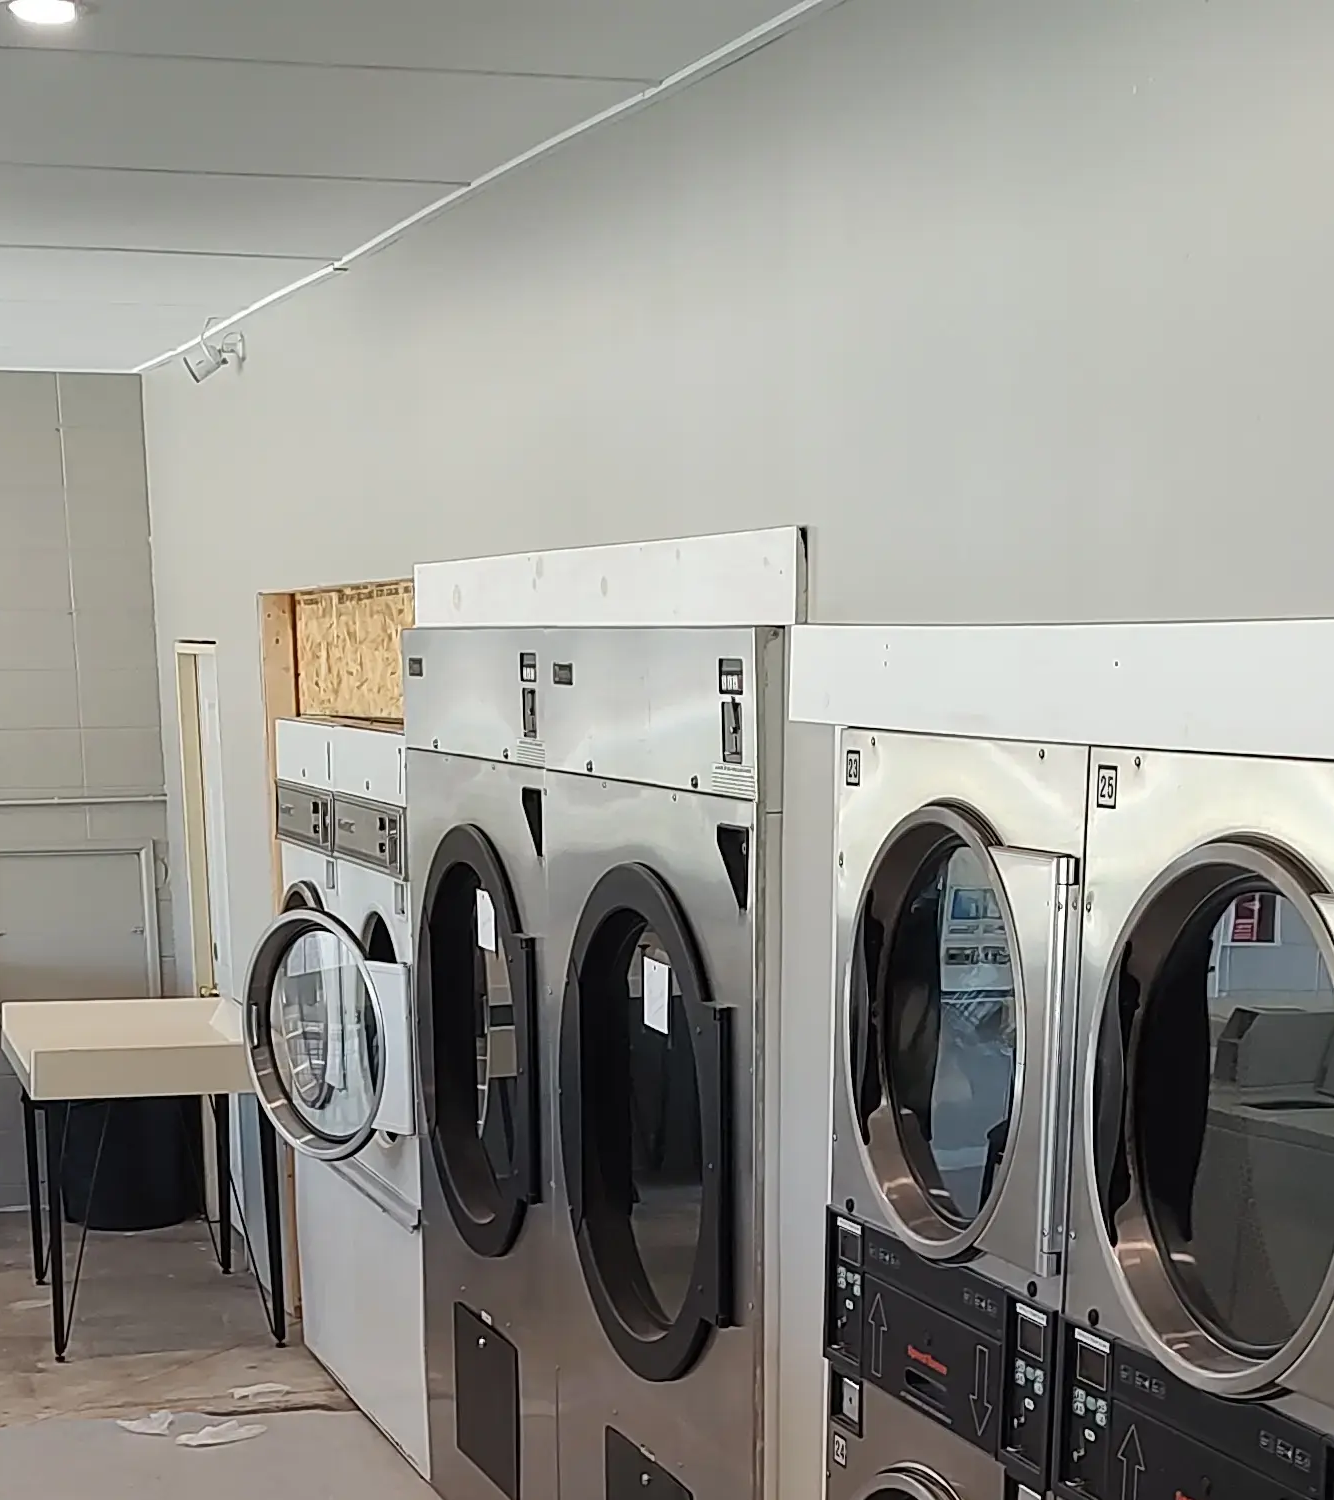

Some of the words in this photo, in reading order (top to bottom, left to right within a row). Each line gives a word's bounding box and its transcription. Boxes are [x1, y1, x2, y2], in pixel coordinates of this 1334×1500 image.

[848, 758, 858, 778] 23
[1100, 775, 1114, 799] 25
[835, 1439, 845, 1460] 24
